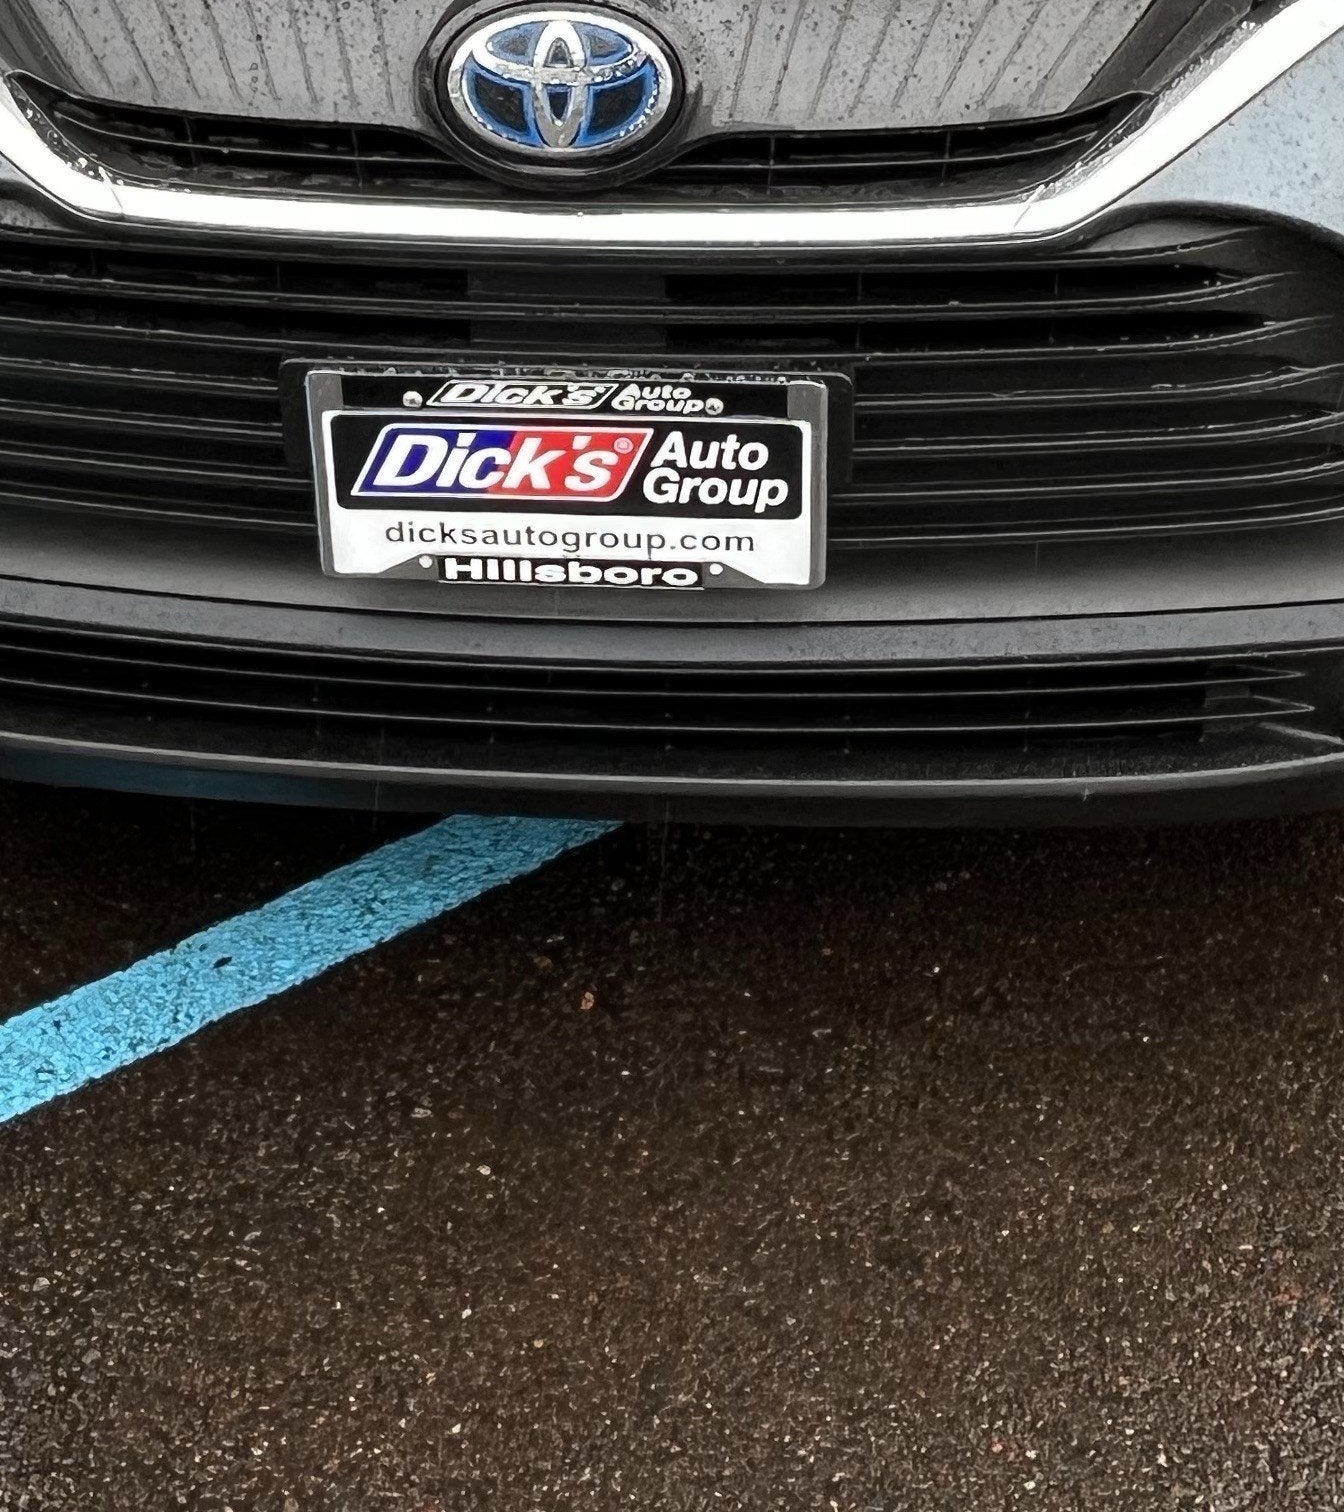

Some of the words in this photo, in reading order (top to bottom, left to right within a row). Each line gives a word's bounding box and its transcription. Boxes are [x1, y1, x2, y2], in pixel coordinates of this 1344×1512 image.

[610, 394, 705, 414] Group
[613, 383, 692, 400] Auto
[372, 432, 619, 492] Dick's
[650, 431, 769, 471] Auto
[642, 467, 789, 513] Group
[385, 521, 755, 553] dicksautogroup.com
[444, 557, 699, 587] Hillsboro
